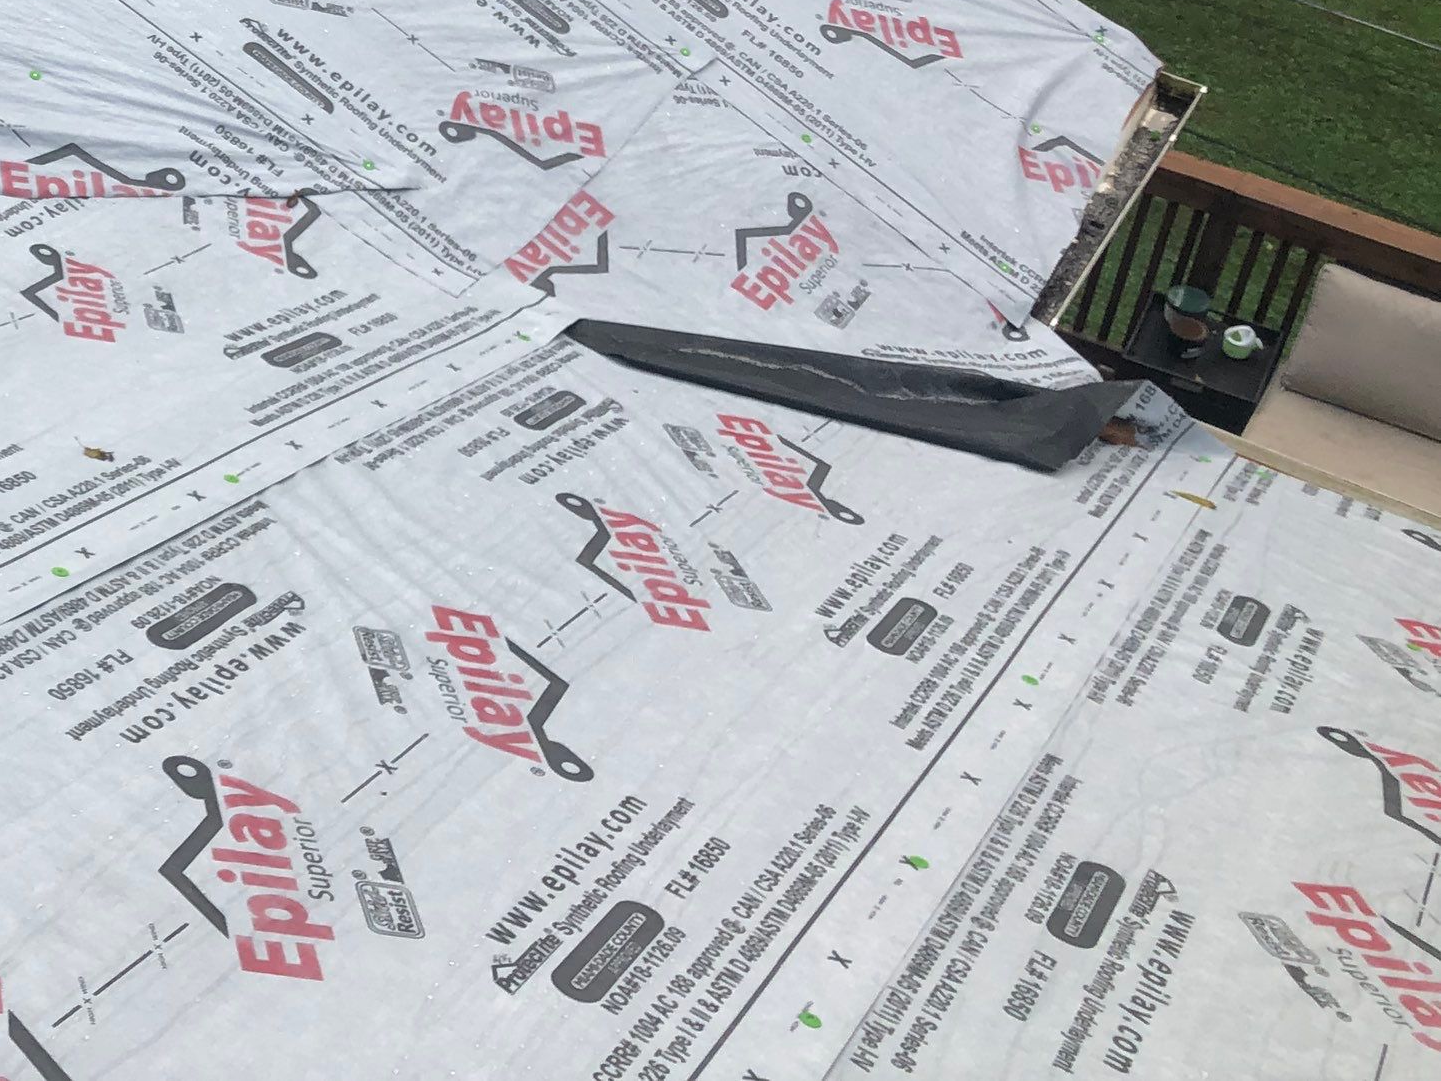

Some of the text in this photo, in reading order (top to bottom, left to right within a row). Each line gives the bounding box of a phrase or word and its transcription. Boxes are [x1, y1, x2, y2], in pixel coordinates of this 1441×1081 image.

[276, 28, 438, 157] www.epilay.com
[741, 29, 804, 78] FL# 16850
[449, 90, 606, 158] Epilay
[475, 89, 540, 111] Superior
[215, 123, 284, 178] FL# 16850
[56, 257, 126, 343] Epilay
[730, 214, 839, 312] Epilay
[798, 254, 838, 296] Superior
[223, 288, 350, 343] www.epilay.com
[518, 417, 630, 485] www.epilay.com
[717, 414, 826, 514] Epilay
[599, 506, 711, 632] Epilay
[663, 534, 703, 587] Superior
[815, 532, 909, 620] www.epilay.com
[47, 648, 134, 701] FL# 16850
[120, 622, 308, 744] www.epilay.com
[425, 605, 542, 763] Epilay
[425, 655, 468, 723] Superior
[1269, 628, 1325, 714] www.epilay.com
[211, 774, 335, 981] Epilay
[297, 817, 334, 902] Superior
[486, 795, 648, 945] www.epilay.com
[665, 836, 731, 899] FL# 16850
[1003, 950, 1057, 1021] FL# 16850
[1103, 911, 1196, 1074] www.epilay.com
[1327, 947, 1413, 1029] Superior
